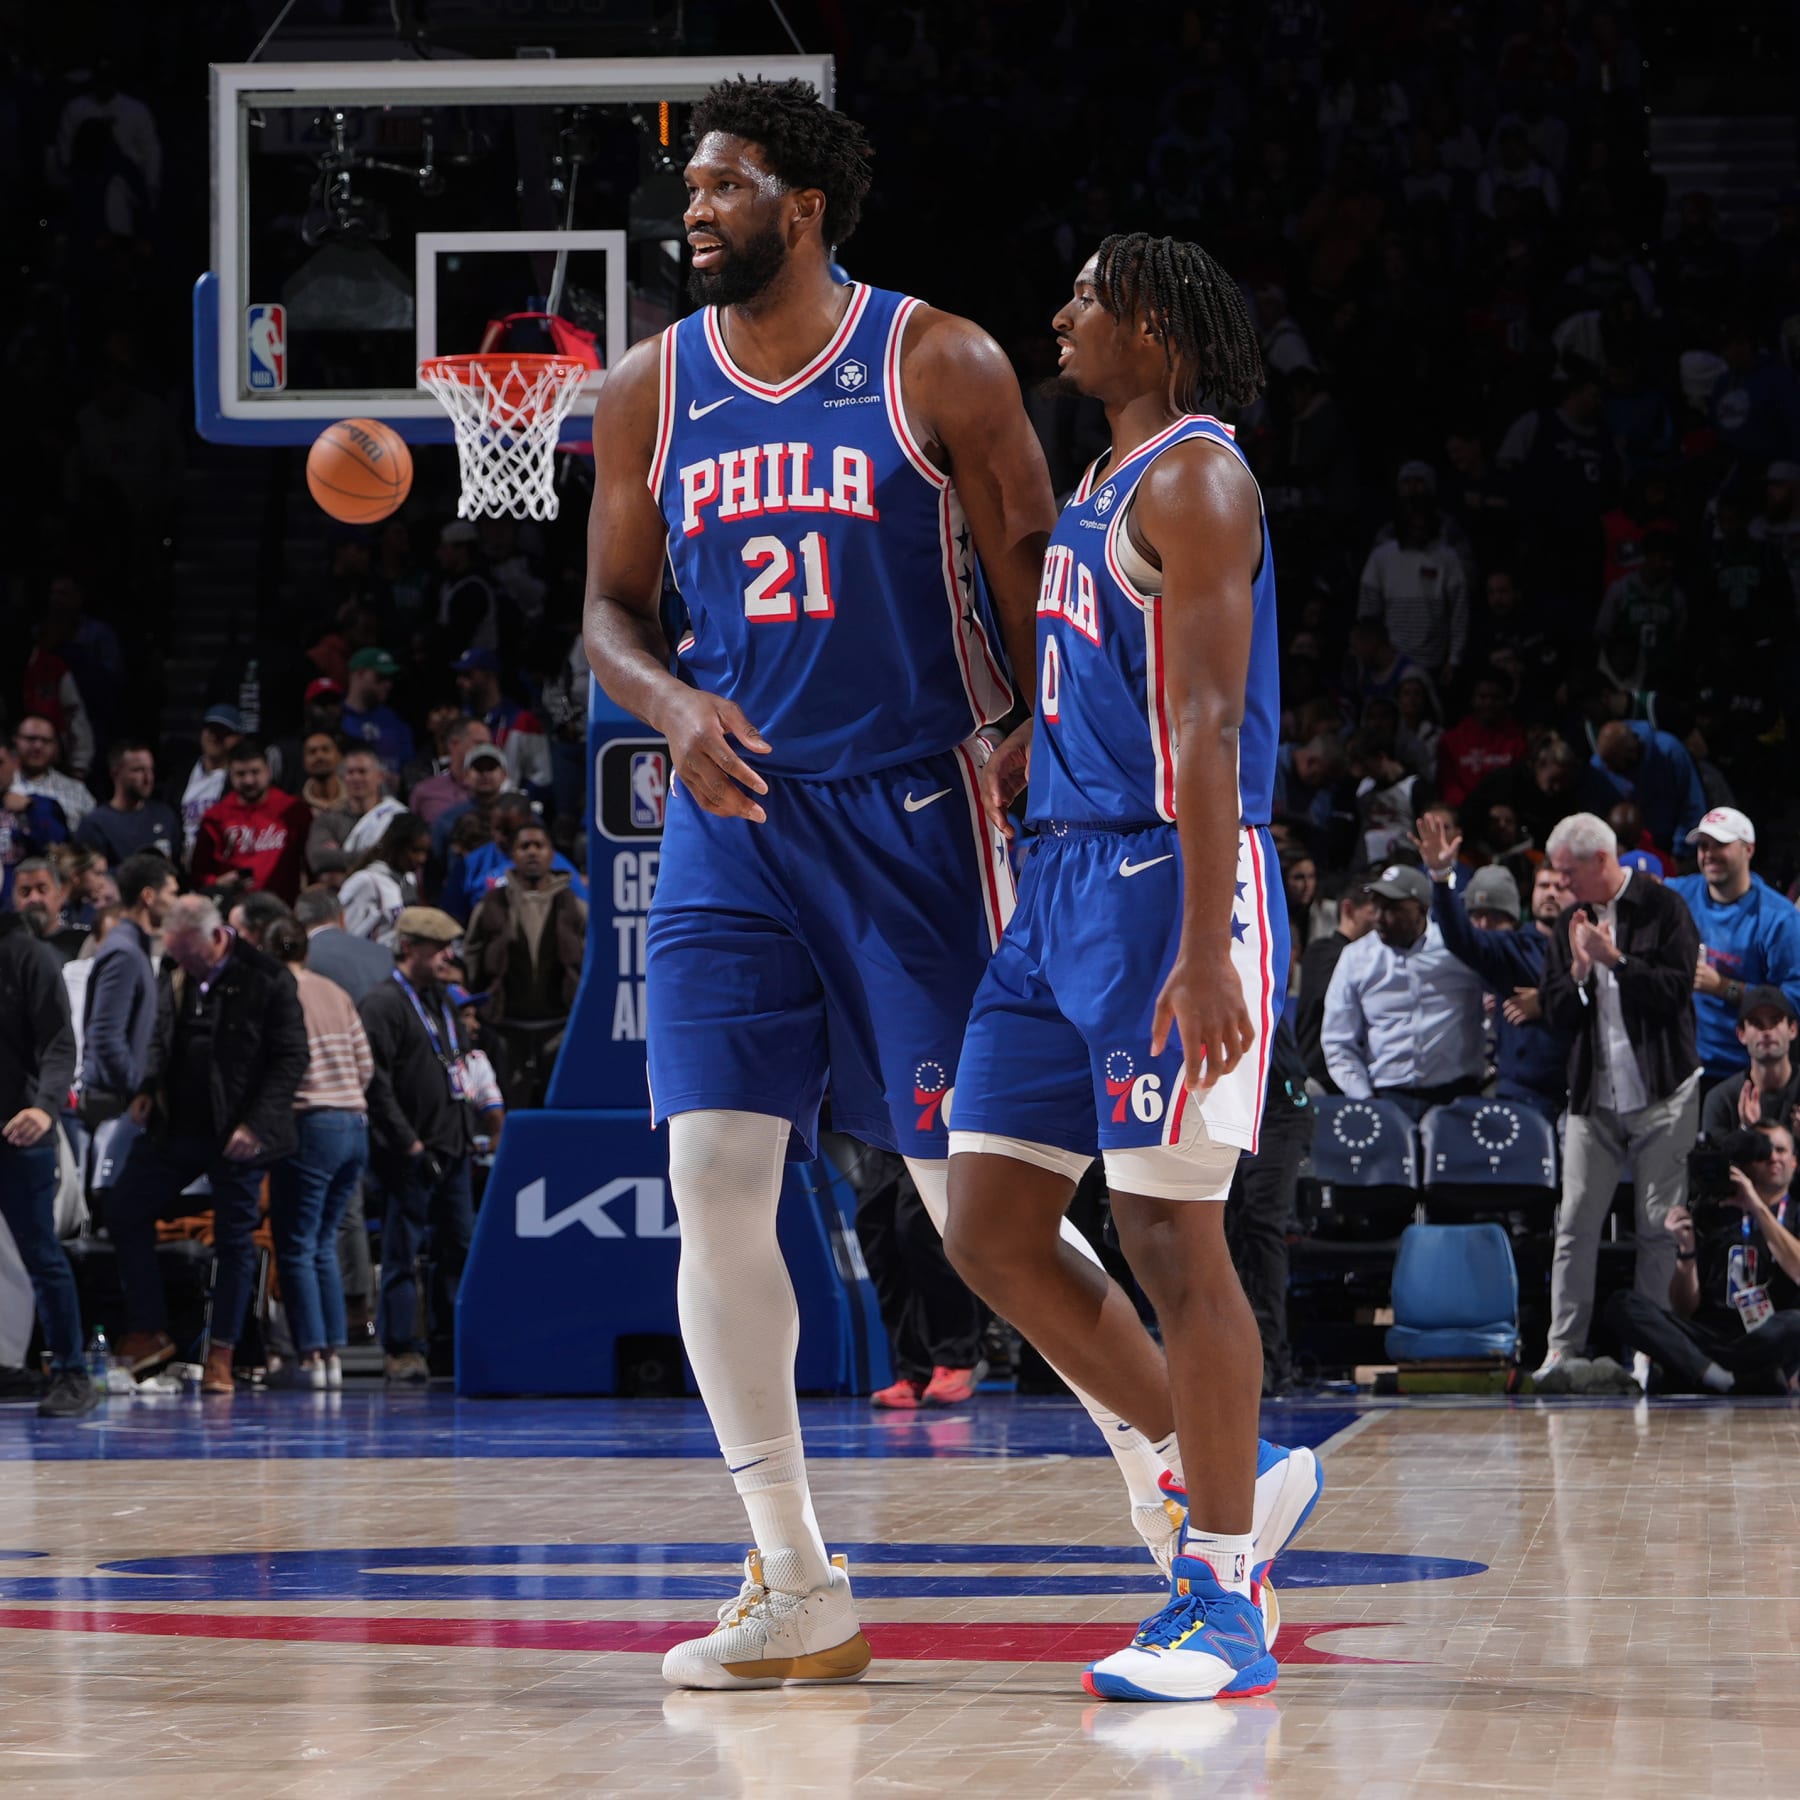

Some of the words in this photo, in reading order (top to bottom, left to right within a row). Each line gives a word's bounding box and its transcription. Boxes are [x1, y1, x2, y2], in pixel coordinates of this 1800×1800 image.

[823, 394, 880, 409] crypto.com
[679, 441, 880, 538] PHILA
[741, 531, 836, 624] 21
[1041, 634, 1060, 724] 0
[1105, 1073, 1164, 1123] 76
[516, 1176, 681, 1238] KI
